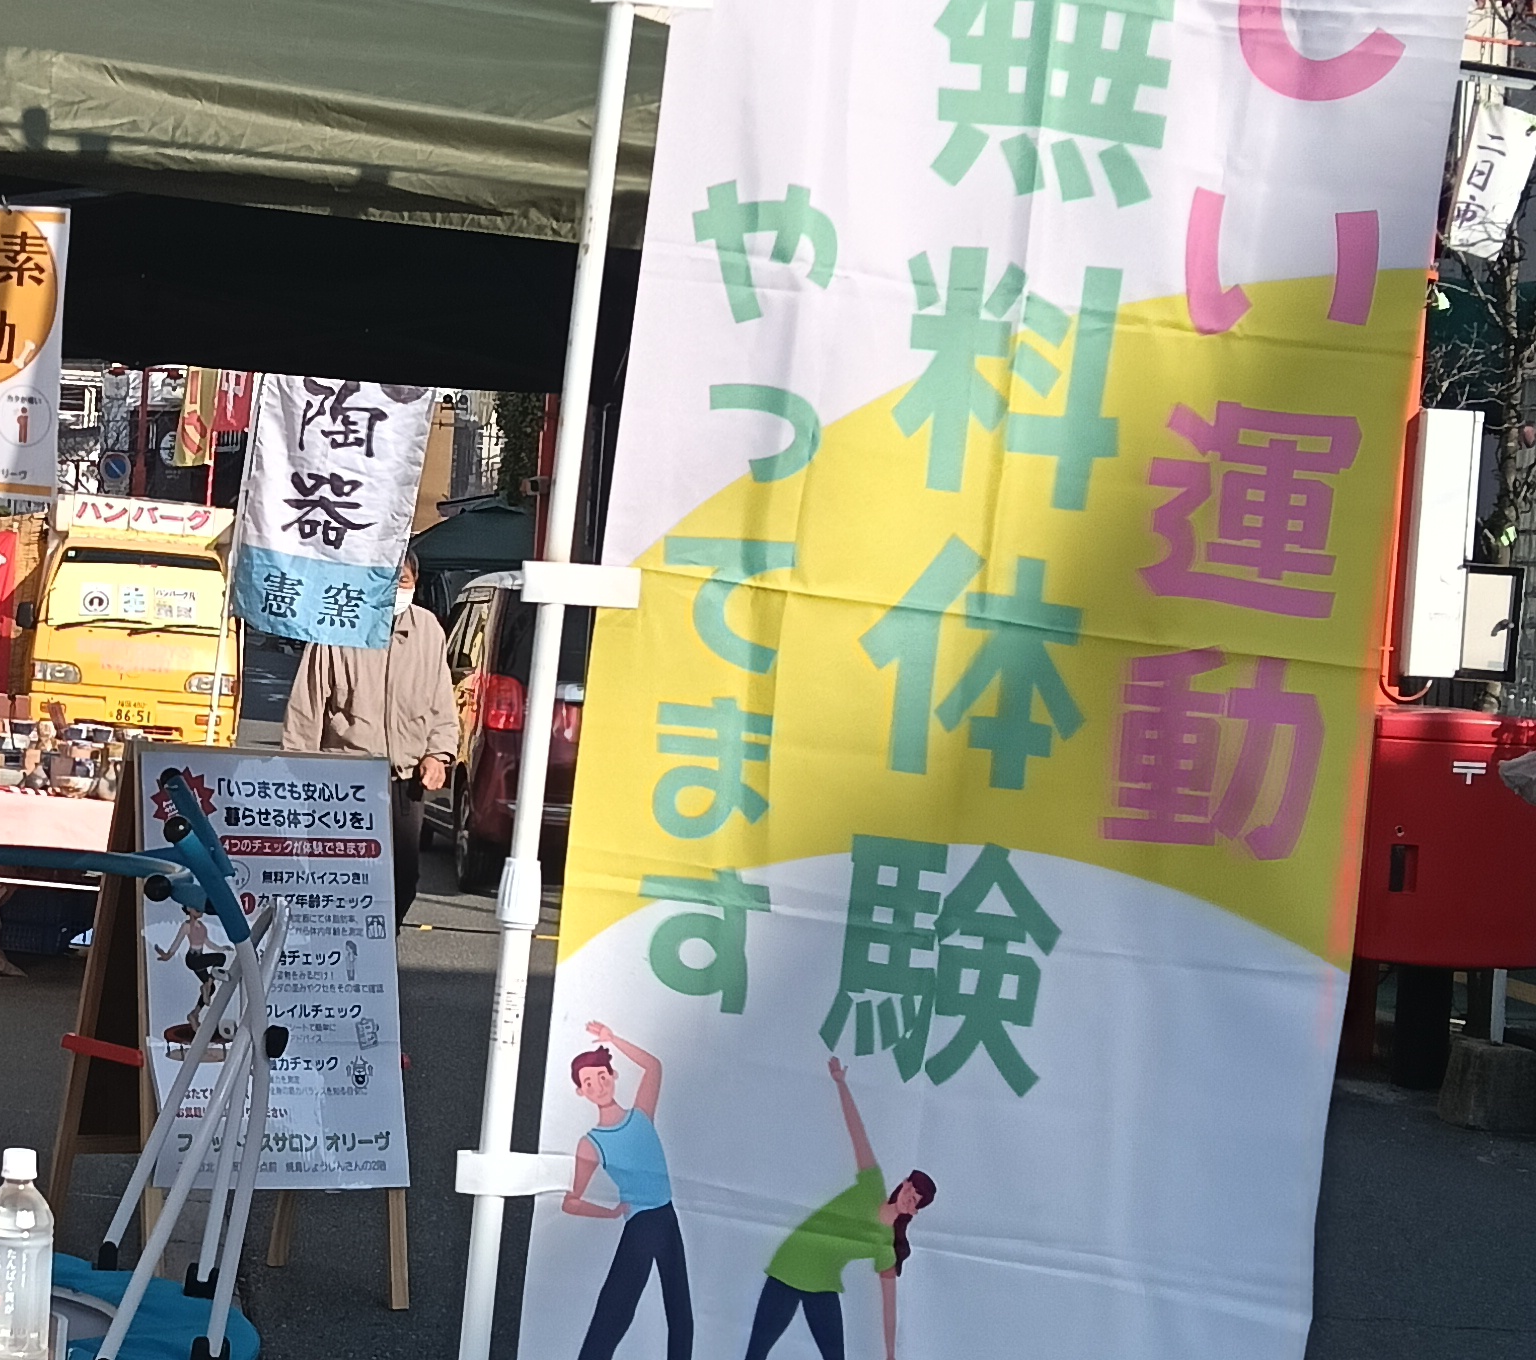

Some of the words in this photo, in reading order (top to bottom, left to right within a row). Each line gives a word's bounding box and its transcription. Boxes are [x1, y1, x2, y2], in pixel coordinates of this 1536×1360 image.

[282, 377, 389, 550] 陶器
[76, 499, 211, 531] ハンバーグ
[638, 180, 839, 1015] やってます
[217, 778, 366, 803] 「いつまでも安心して
[224, 806, 375, 831] 暮らせる体づくりを」
[326, 1131, 391, 1153] オリーヴ
